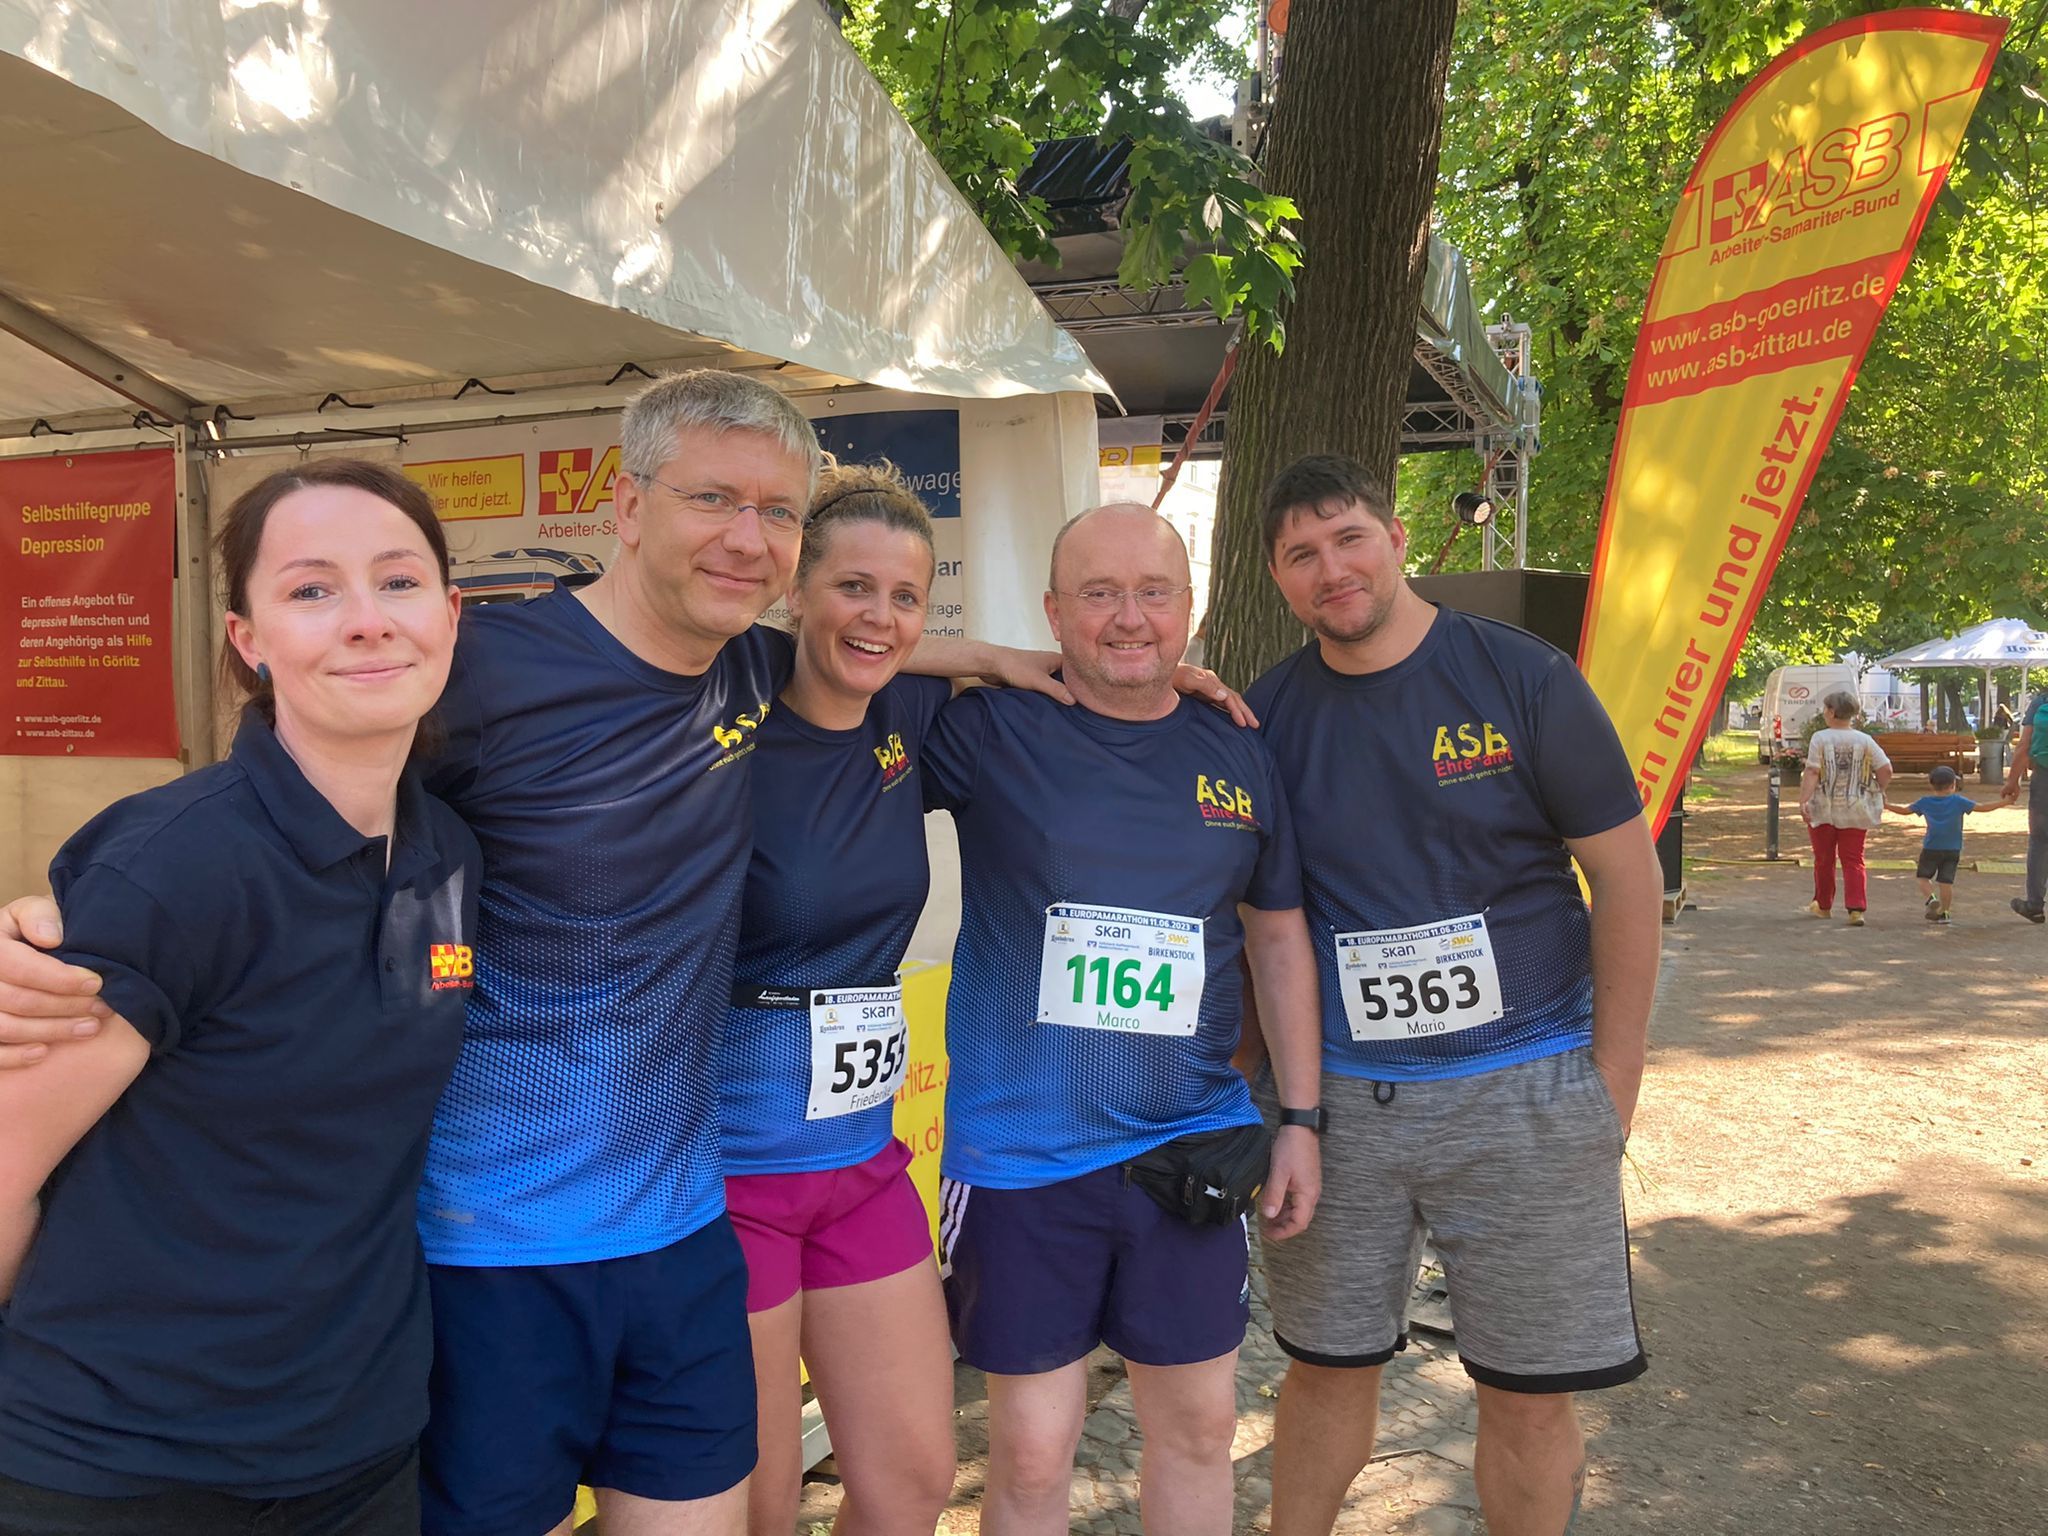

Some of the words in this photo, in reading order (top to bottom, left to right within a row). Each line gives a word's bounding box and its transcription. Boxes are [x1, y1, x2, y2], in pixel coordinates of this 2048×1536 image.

[1746, 111, 1910, 232] ASB
[1709, 189, 1900, 266] Arbeiter-Samariter-Bund
[1650, 273, 1886, 355] www.asb-goerlitz.de
[1647, 318, 1852, 388] www.asb-zittau.de
[428, 473, 448, 488] Wir
[451, 471, 492, 487] helfen
[453, 494, 477, 509] und
[480, 491, 512, 511] jetzt.
[1699, 523, 1763, 628] und
[1740, 386, 1823, 520] jetzt.
[22, 501, 151, 523] Selbsthilfegruppe
[538, 519, 619, 539] Arbeiter-Sa
[21, 534, 105, 558] Depression
[21, 596, 37, 609] Ein
[39, 595, 71, 608] offenes
[72, 593, 115, 609] Angebot
[117, 593, 134, 605] für
[21, 616, 68, 630] depressive
[69, 613, 125, 627] Menschen
[127, 613, 150, 626] und
[19, 636, 44, 648] deren
[45, 634, 104, 650] Angehörige
[106, 634, 124, 647] als
[126, 634, 153, 647] Hilfe
[17, 657, 32, 668] zur
[33, 655, 86, 668] Selbsthilfe
[88, 655, 99, 667] in
[102, 655, 141, 667] Görlitz
[16, 677, 34, 688] und
[35, 675, 68, 688] Zittau.
[23, 715, 102, 725] www.asb-goerlitz.de
[25, 729, 95, 738] www.asb-zittau.de
[1196, 774, 1253, 820] ASB
[1069, 910, 1149, 925] EUROPAMARATHON
[1150, 918, 1191, 930] 11.06.2023
[1357, 930, 1430, 946] EUROPAMARATHON
[1430, 922, 1473, 937] 11.06.2023
[1148, 947, 1195, 961] BIRKENSTOCK
[1435, 948, 1484, 965] BIRKENSTOCK
[1066, 954, 1175, 1012] 1164
[1359, 965, 1480, 1021] 5363
[1097, 1011, 1140, 1030] Marco
[1406, 1018, 1446, 1036] Mario
